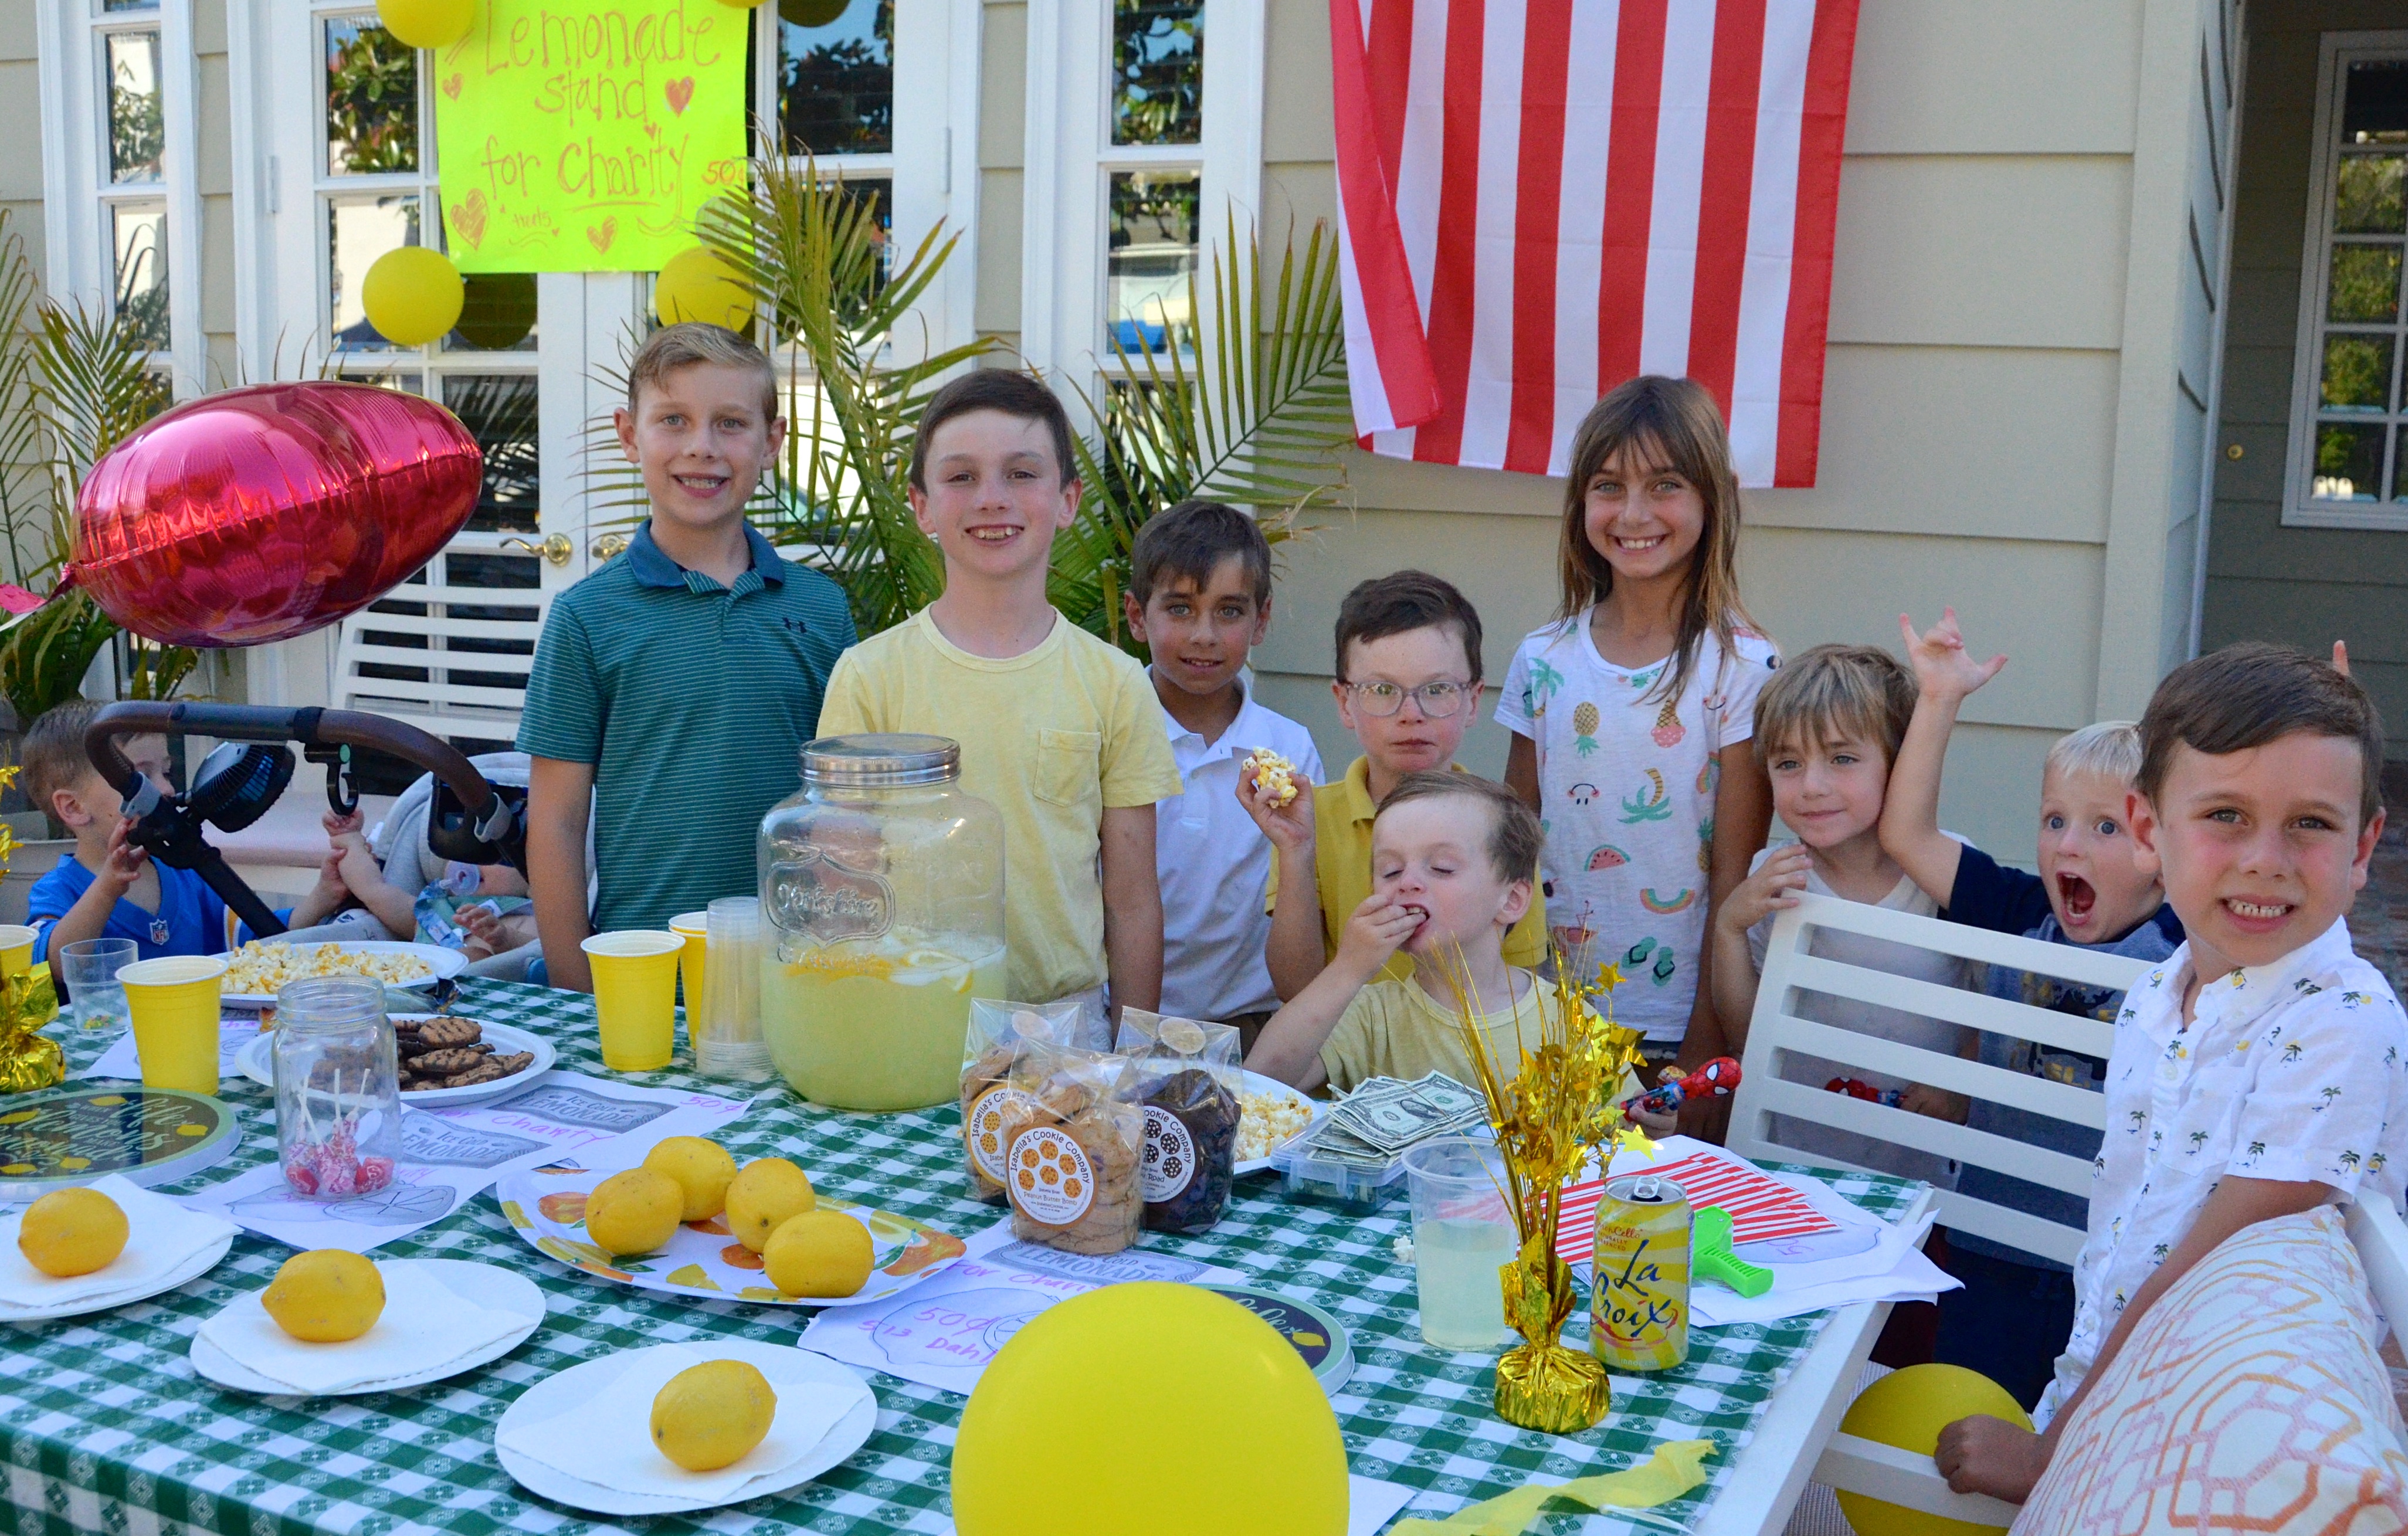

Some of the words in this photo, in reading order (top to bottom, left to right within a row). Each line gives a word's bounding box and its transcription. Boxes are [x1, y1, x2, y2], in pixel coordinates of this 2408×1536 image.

[486, 0, 721, 75] Lemonade
[534, 60, 649, 127] stand
[481, 134, 541, 200] for
[558, 127, 690, 230] Charity
[518, 1098, 635, 1124] LEMONADE
[565, 1095, 588, 1107] ICE
[680, 1096, 746, 1114] 50¢
[972, 1098, 993, 1137] Isabella's
[402, 1134, 503, 1158] EMONADE
[1144, 1110, 1170, 1123] ookie
[1169, 1121, 1192, 1164] Company
[1010, 1135, 1032, 1172] Isabella's
[1033, 1131, 1064, 1143] Cookie
[1065, 1141, 1090, 1184] Company
[1023, 1191, 1042, 1200] Peanut
[1148, 1173, 1165, 1183] Road
[1017, 1247, 1165, 1282] LEMONADE
[1613, 1239, 1662, 1297] La
[913, 1306, 1001, 1337] 50¢
